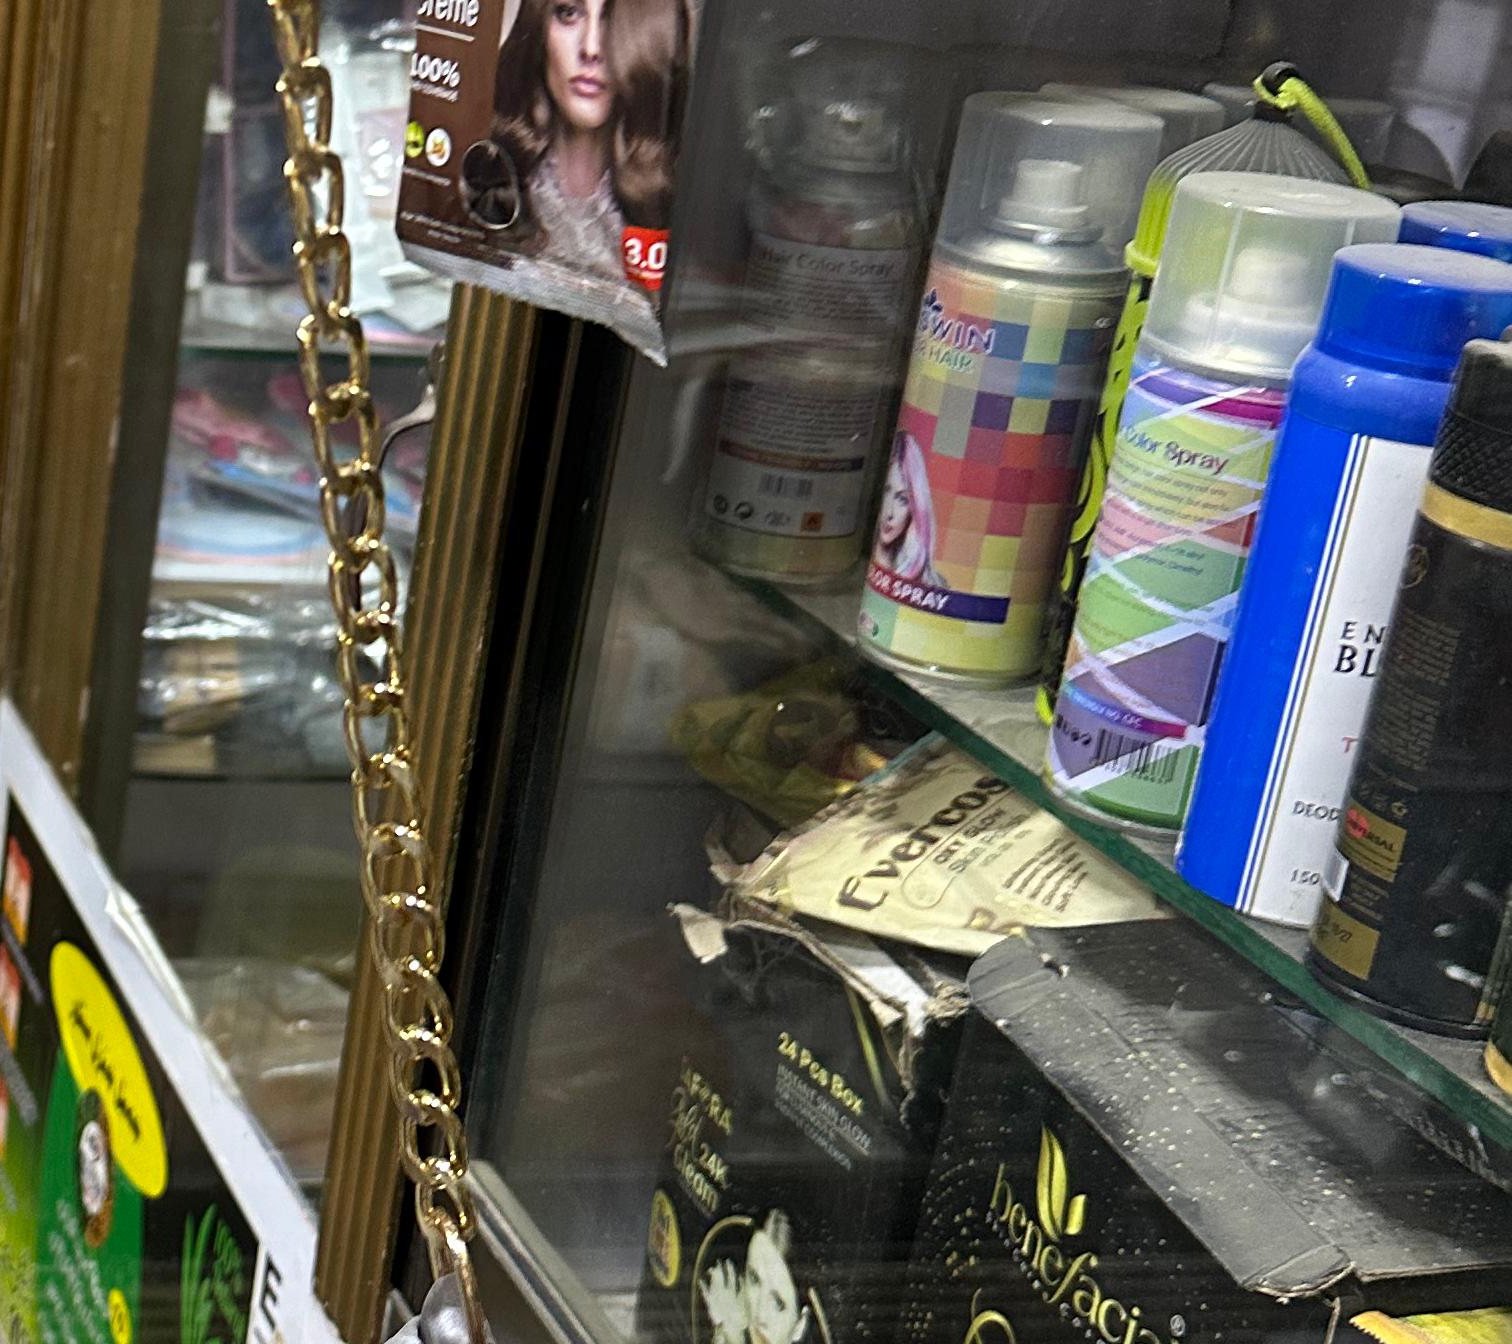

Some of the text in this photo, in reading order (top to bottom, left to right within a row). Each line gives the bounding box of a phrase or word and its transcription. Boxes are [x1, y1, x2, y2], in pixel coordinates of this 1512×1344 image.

[409, 51, 461, 89] 100%
[623, 236, 670, 270] 3.0
[796, 252, 845, 275] Color
[849, 258, 897, 280] Spray
[1163, 439, 1231, 476] Spray
[891, 579, 951, 611] SPRAY
[1289, 867, 1321, 887] 150
[777, 1030, 865, 1117] 24 Pcs Box
